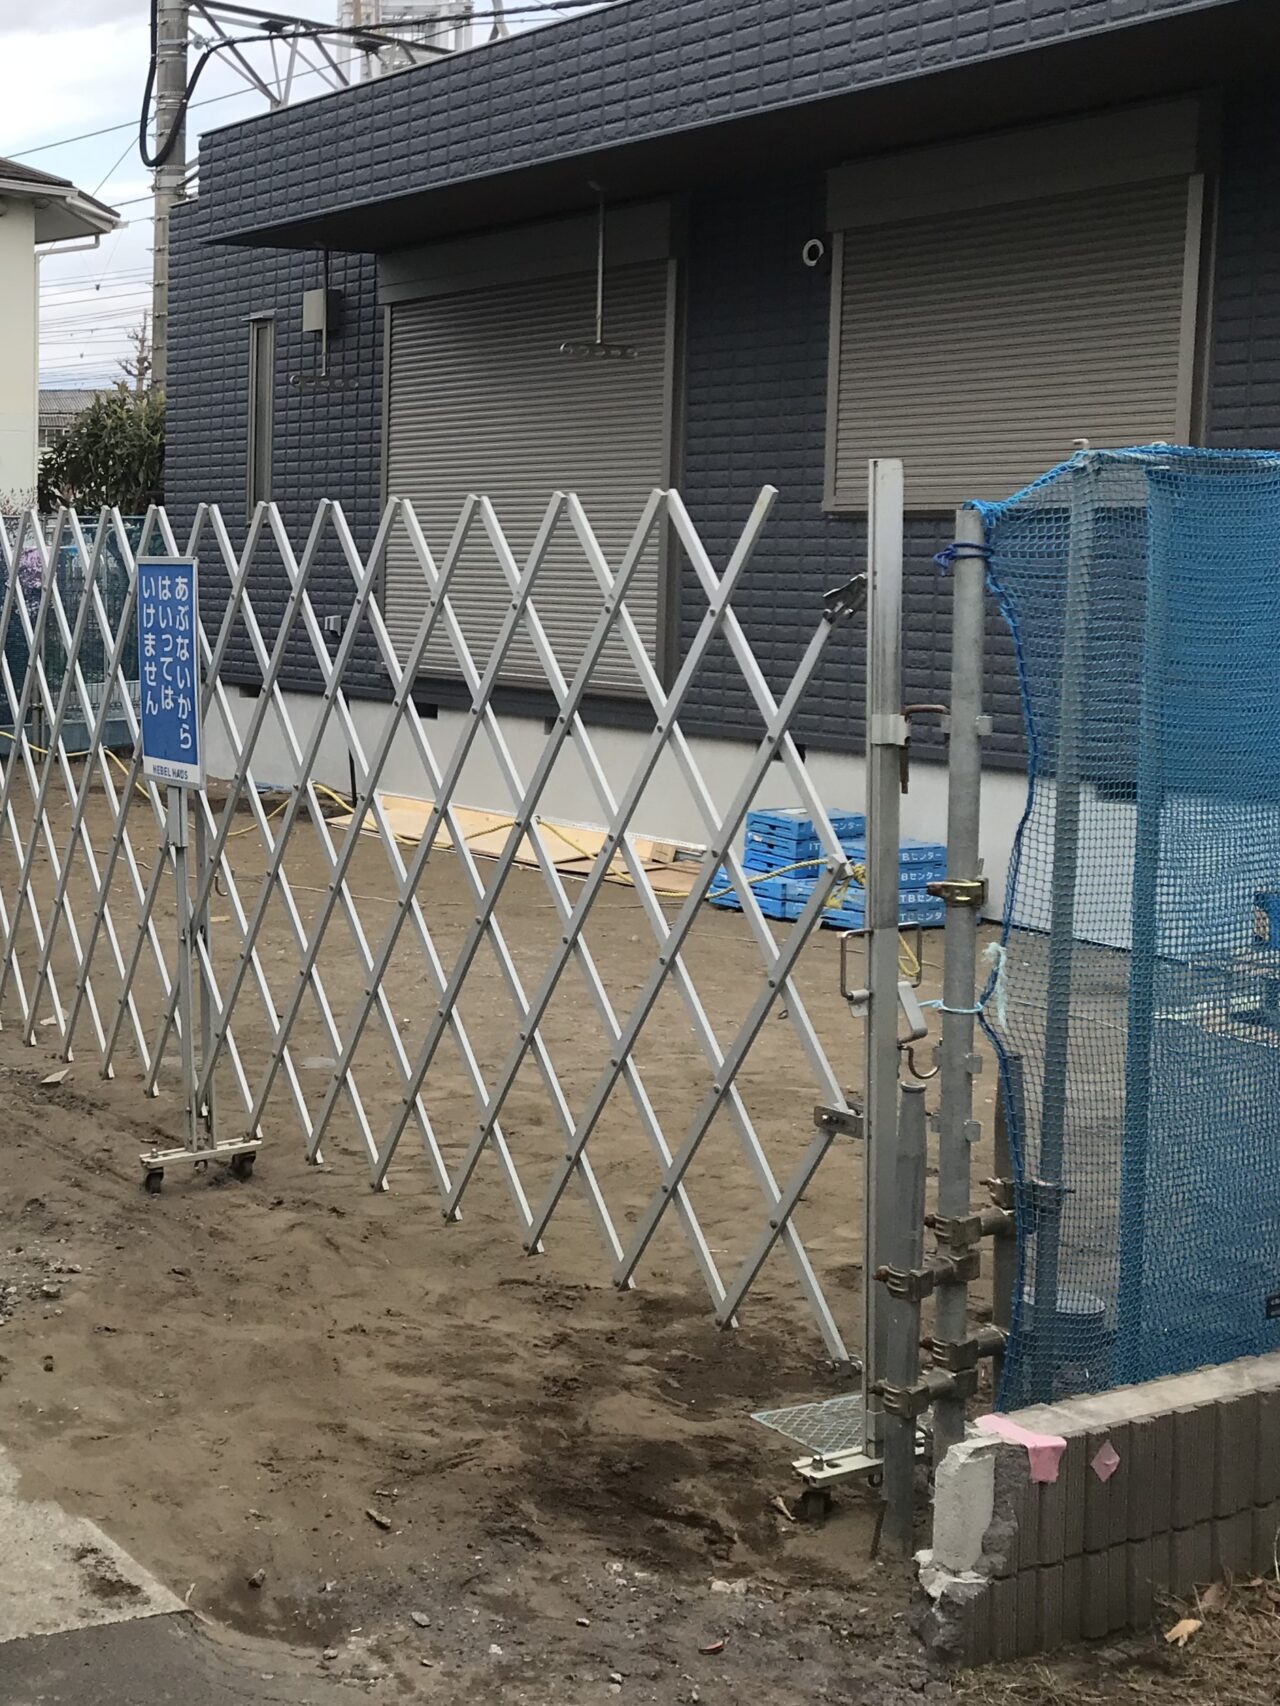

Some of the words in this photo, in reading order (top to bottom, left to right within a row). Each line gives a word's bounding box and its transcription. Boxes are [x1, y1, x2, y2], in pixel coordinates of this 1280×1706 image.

[142, 575, 159, 715] いけません
[158, 575, 174, 710] はいっては
[175, 575, 192, 749] あぶないから
[153, 765, 171, 777] HEBEL
[900, 871, 942, 881] Bセンター
[901, 851, 942, 861] Bセンター
